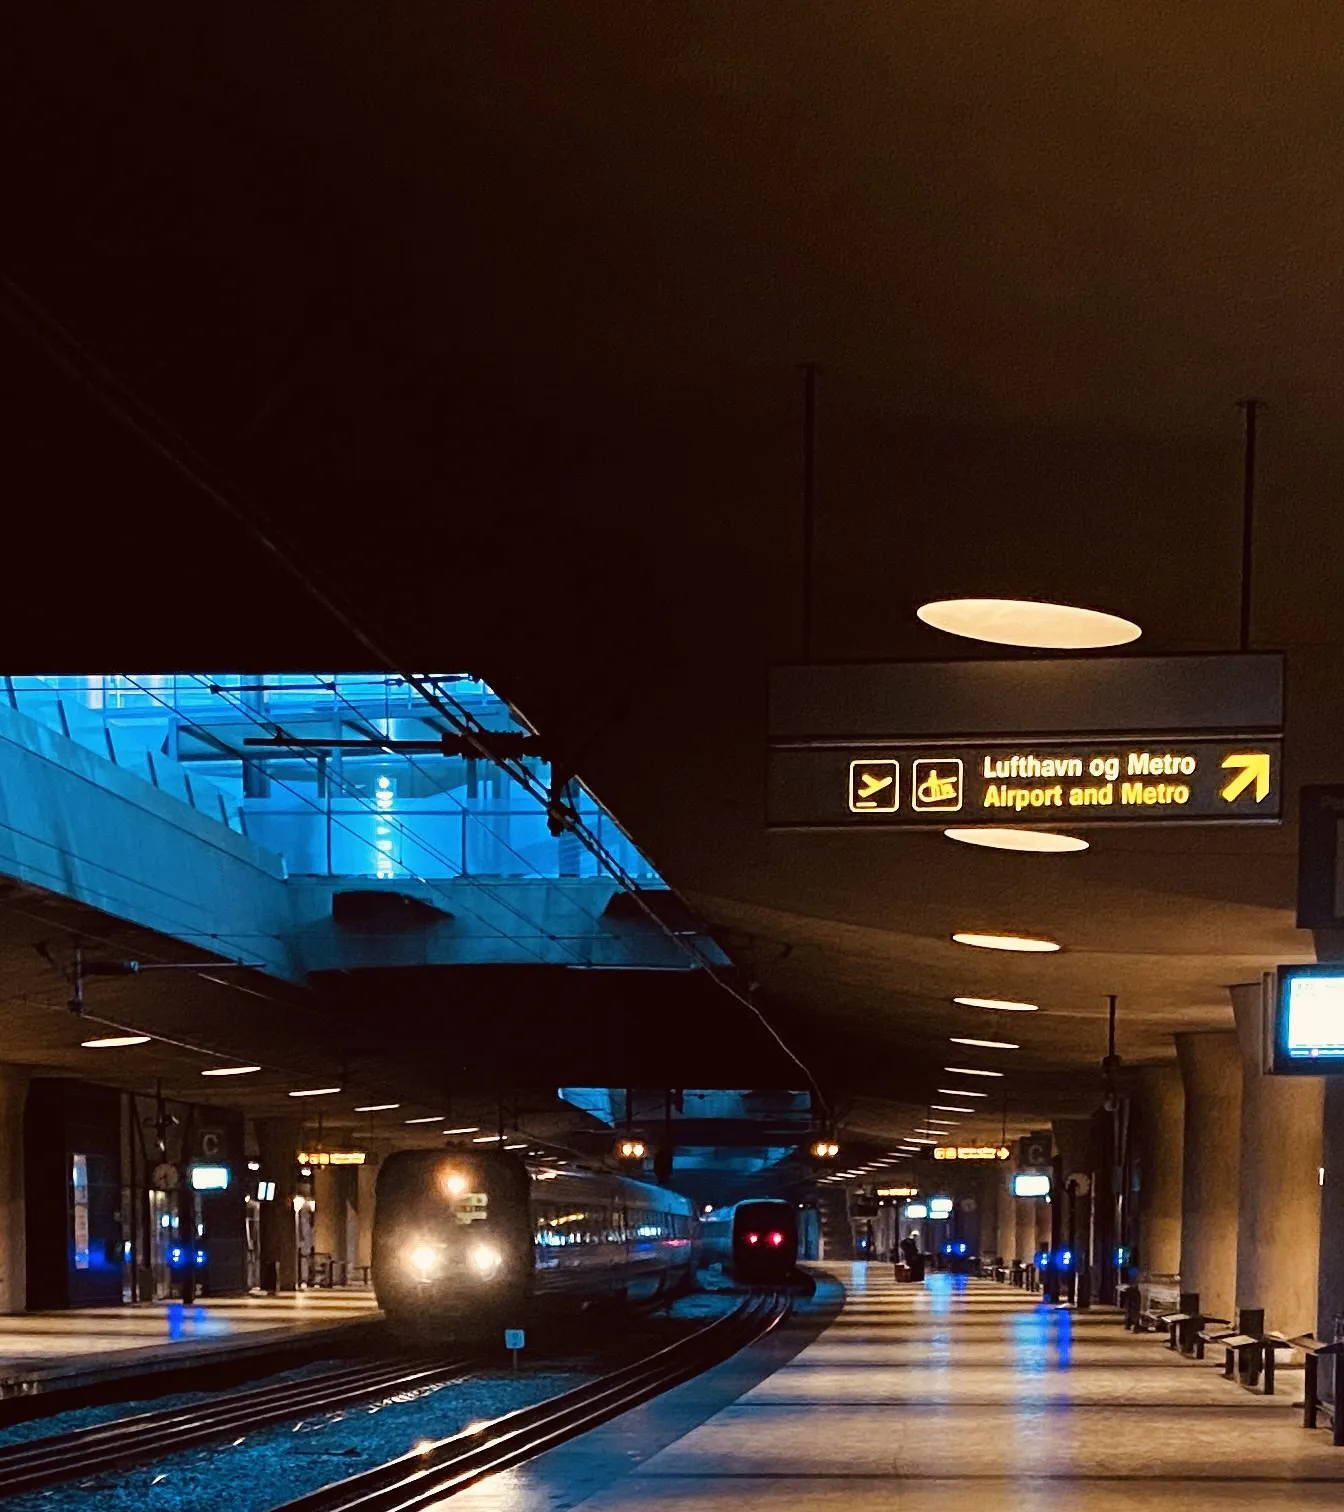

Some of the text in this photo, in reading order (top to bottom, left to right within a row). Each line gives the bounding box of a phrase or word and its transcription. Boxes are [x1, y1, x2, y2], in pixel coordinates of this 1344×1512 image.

[983, 752, 1196, 781] Lufthavn og Metro
[983, 782, 1190, 812] Airport and Metro
[203, 1134, 218, 1155] C
